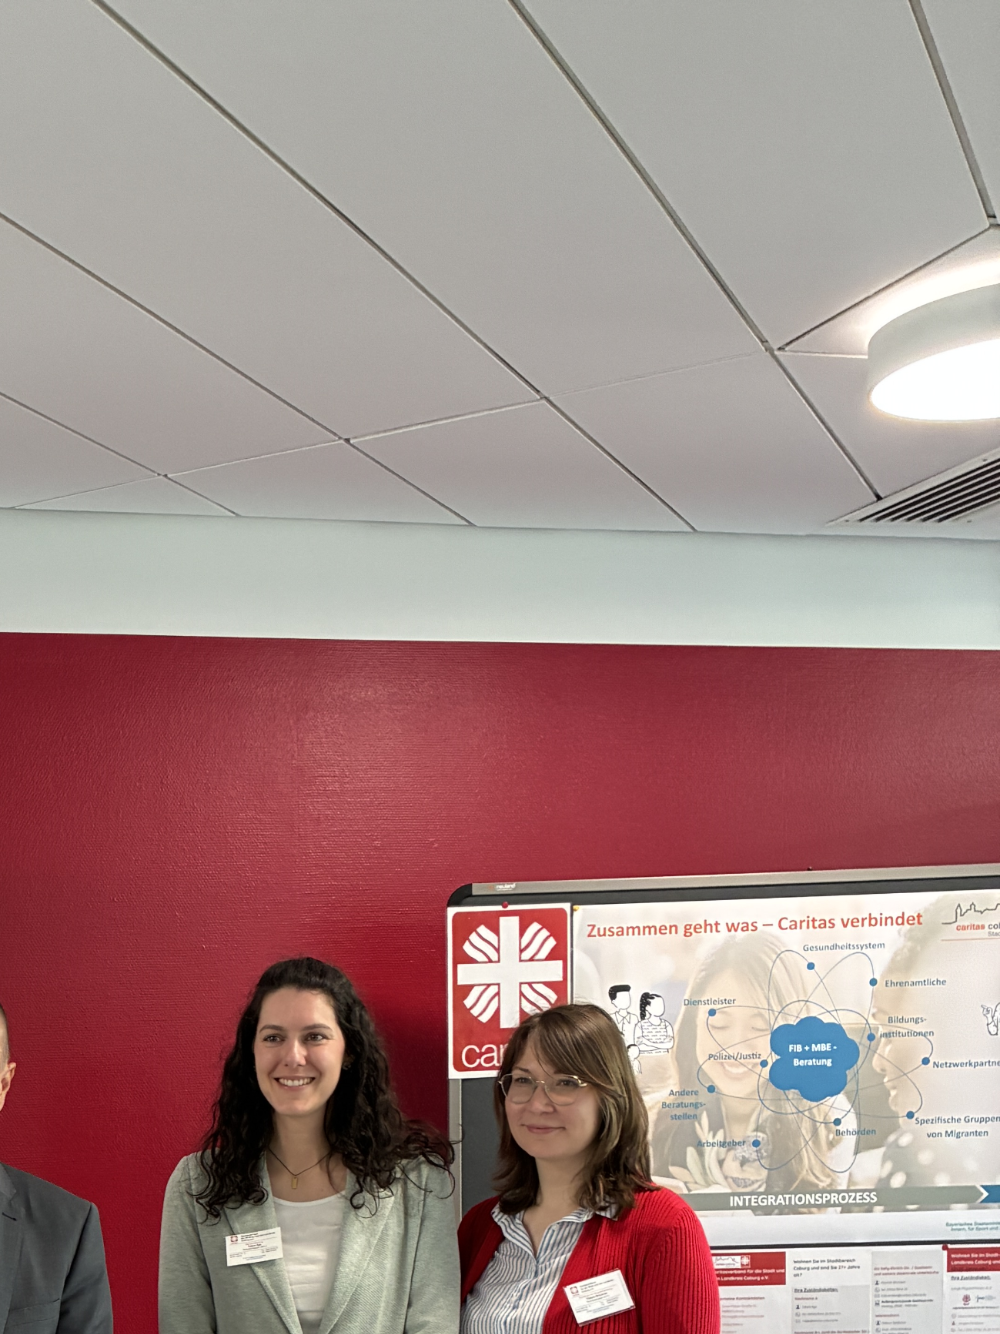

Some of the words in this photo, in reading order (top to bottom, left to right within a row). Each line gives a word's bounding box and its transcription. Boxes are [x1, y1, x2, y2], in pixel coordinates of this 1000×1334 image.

[587, 924, 678, 938] Zusammen
[684, 920, 720, 937] geht
[725, 922, 758, 933] was
[778, 916, 835, 931] Caritas
[841, 912, 923, 928] verbindet
[956, 923, 985, 931] caritas
[803, 942, 885, 952] Gesundheitssystem
[885, 978, 947, 988] Ehrenamtliche
[683, 998, 736, 1006] Dienstleister
[888, 1016, 927, 1024] Bildungs-
[880, 1030, 934, 1038] institutionen
[789, 1044, 802, 1052] FIB
[708, 1053, 762, 1061] Polizei/Justiz
[794, 1058, 832, 1067] Beratung
[661, 1101, 706, 1109] Beratungs-
[915, 1116, 961, 1125] Spezifische
[945, 1130, 988, 1138] Migranten
[697, 1140, 746, 1148] Arbeitgeber
[729, 1192, 877, 1207] INTEGRATIONSPROZESS
